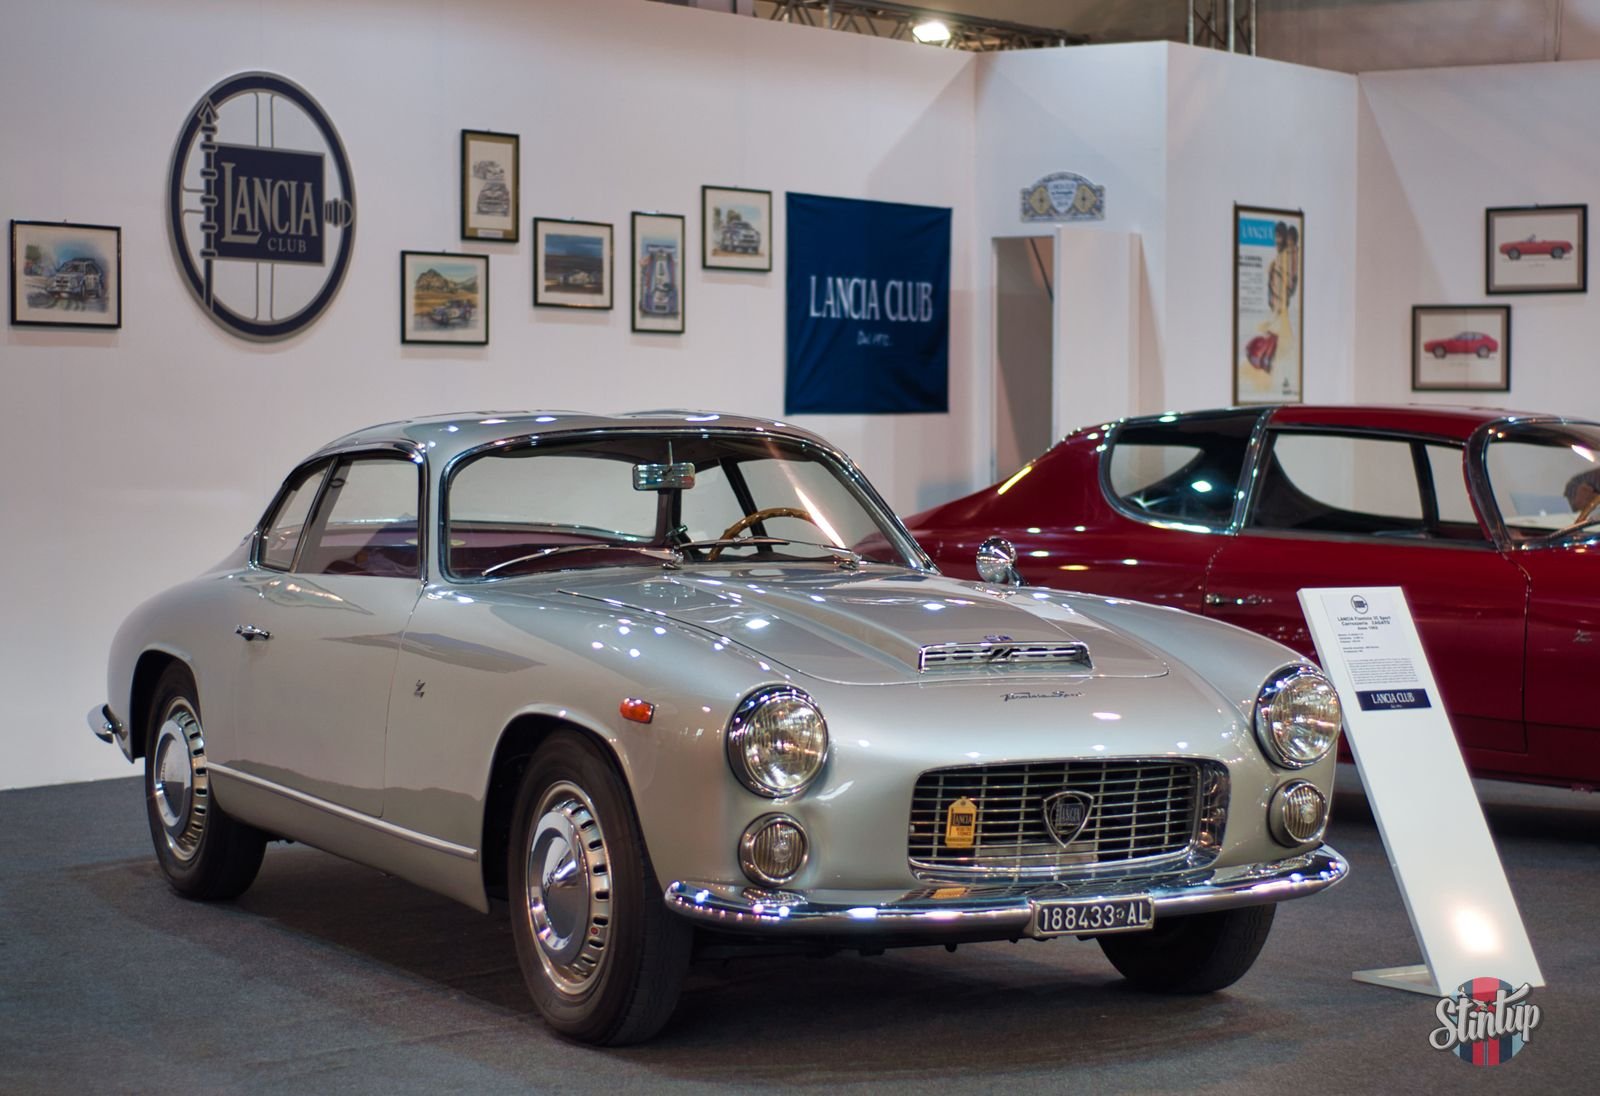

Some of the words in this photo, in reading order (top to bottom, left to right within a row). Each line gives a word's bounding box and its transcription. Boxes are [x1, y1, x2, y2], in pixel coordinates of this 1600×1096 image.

[221, 161, 318, 244] LANCIA
[267, 236, 307, 254] CLUB
[809, 275, 880, 321] LANCIA
[885, 280, 933, 322] CLUB
[1371, 693, 1397, 704] LANCIA
[1396, 692, 1415, 703] CLUB
[953, 813, 972, 826] LANCIA
[1042, 904, 1115, 931] 188433
[1127, 901, 1148, 925] AL
